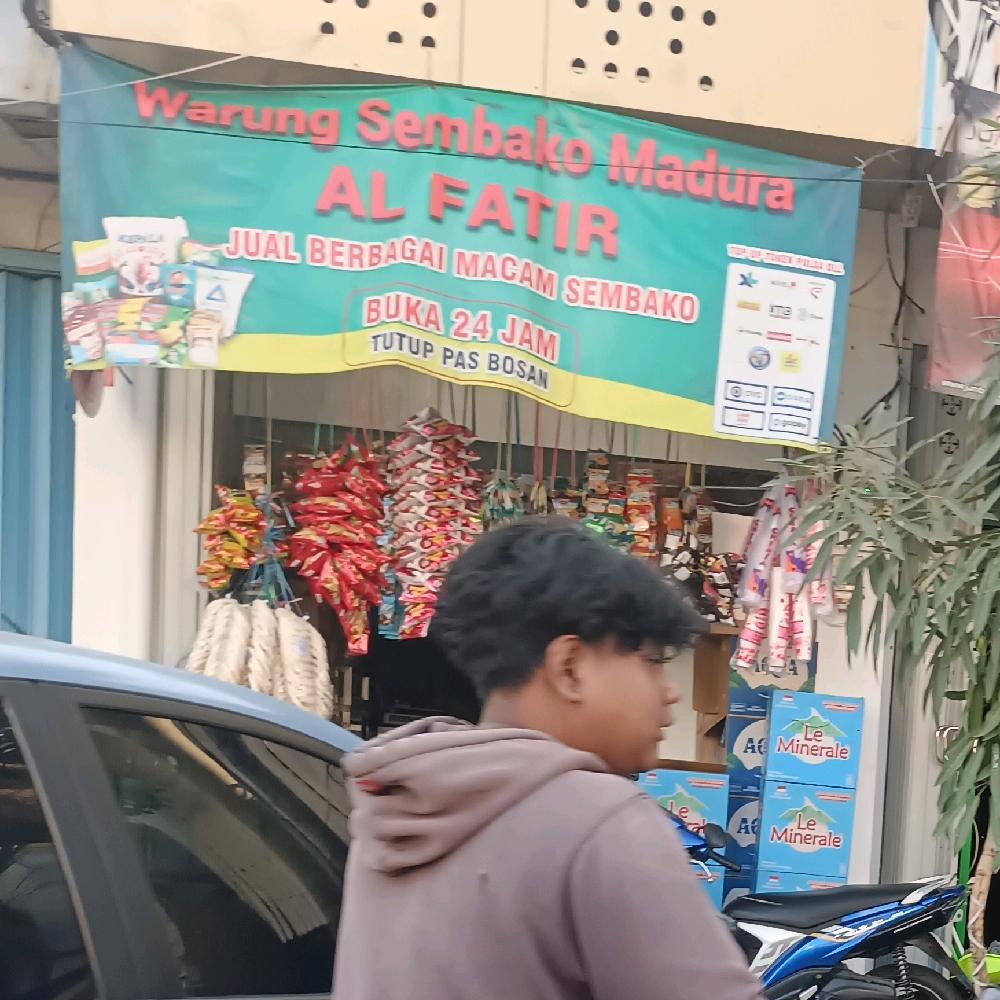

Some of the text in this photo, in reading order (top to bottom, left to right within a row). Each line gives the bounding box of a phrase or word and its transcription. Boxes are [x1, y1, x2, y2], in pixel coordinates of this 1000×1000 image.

[133, 81, 795, 212] Warung Sembako Madura
[315, 165, 619, 258] AL FATIR
[226, 230, 696, 322] JUAL BERBAGAI MACAM SEMBAKO
[366, 294, 557, 362] BUKA 24 JAM
[372, 332, 549, 390] TUTUP PAS BOSAN
[778, 738, 849, 760] Minerale
[804, 725, 823, 743] Le
[668, 802, 690, 819] Le
[796, 814, 816, 831] Le
[771, 826, 842, 848] Minerale
